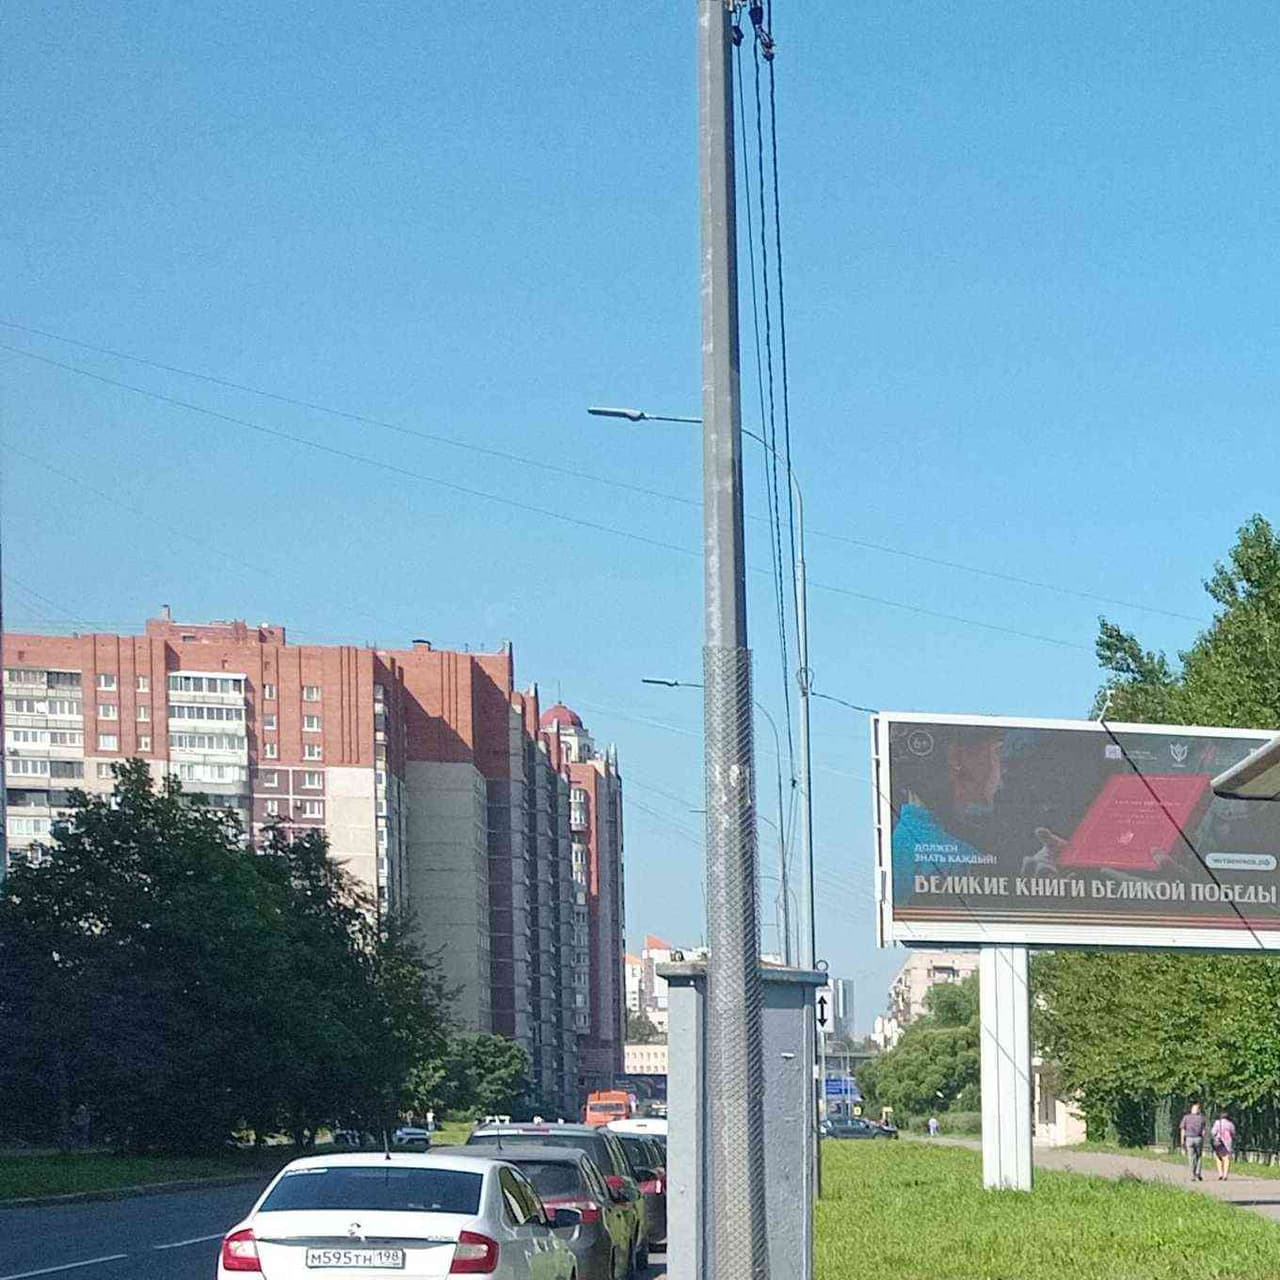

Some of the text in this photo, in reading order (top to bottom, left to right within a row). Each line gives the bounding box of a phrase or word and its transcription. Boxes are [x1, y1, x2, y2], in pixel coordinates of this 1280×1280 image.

[914, 843, 958, 853] ДОЛЖЕН
[914, 853, 998, 865] ЗНАТЬ КАЖДЫЙ!
[914, 875, 1277, 904] ВЕЛИКИЕ КНИГИ ВЕЛИКОЙ ПОБЕДЫ
[378, 1252, 399, 1261] 198
